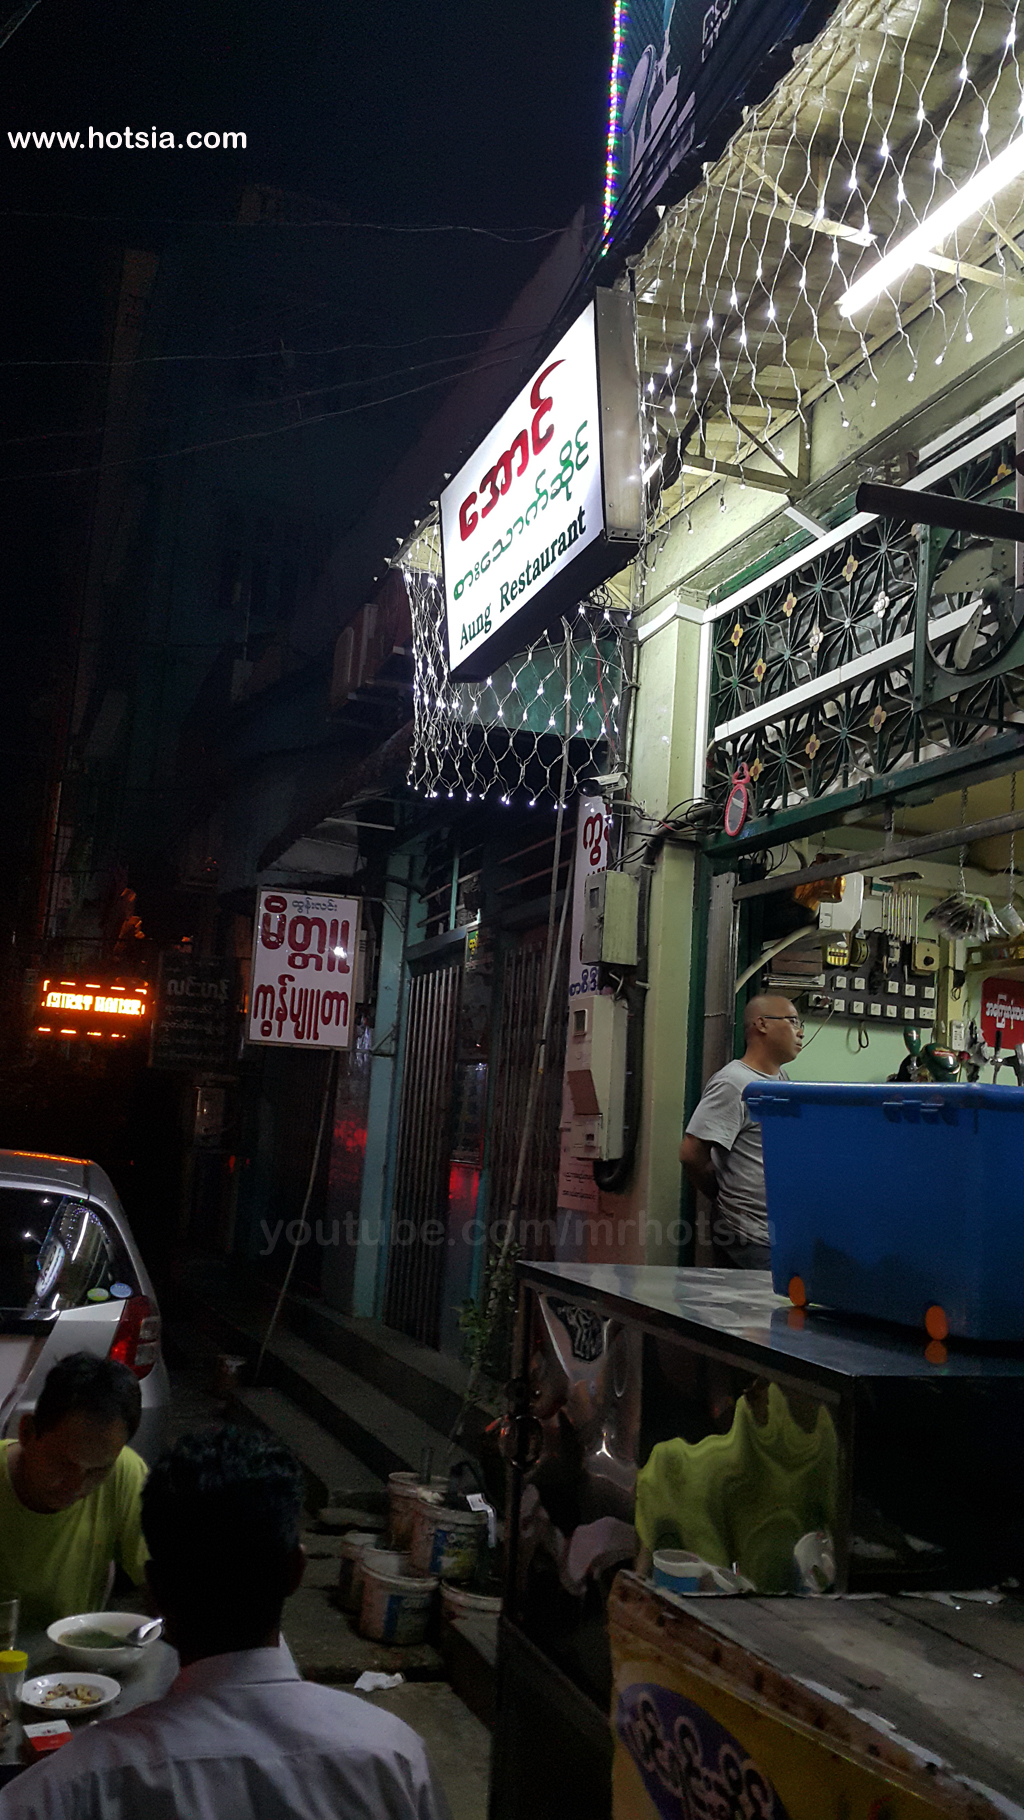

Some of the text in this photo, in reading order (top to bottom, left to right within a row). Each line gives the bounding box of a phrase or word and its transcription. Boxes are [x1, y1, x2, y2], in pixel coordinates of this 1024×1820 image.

[453, 420, 589, 602] စားသောက်ဆိုင်
[460, 358, 565, 542] အောင်
[460, 508, 587, 651] Aung Restaurant
[254, 974, 349, 1041] ကွန်ပျူတာ
